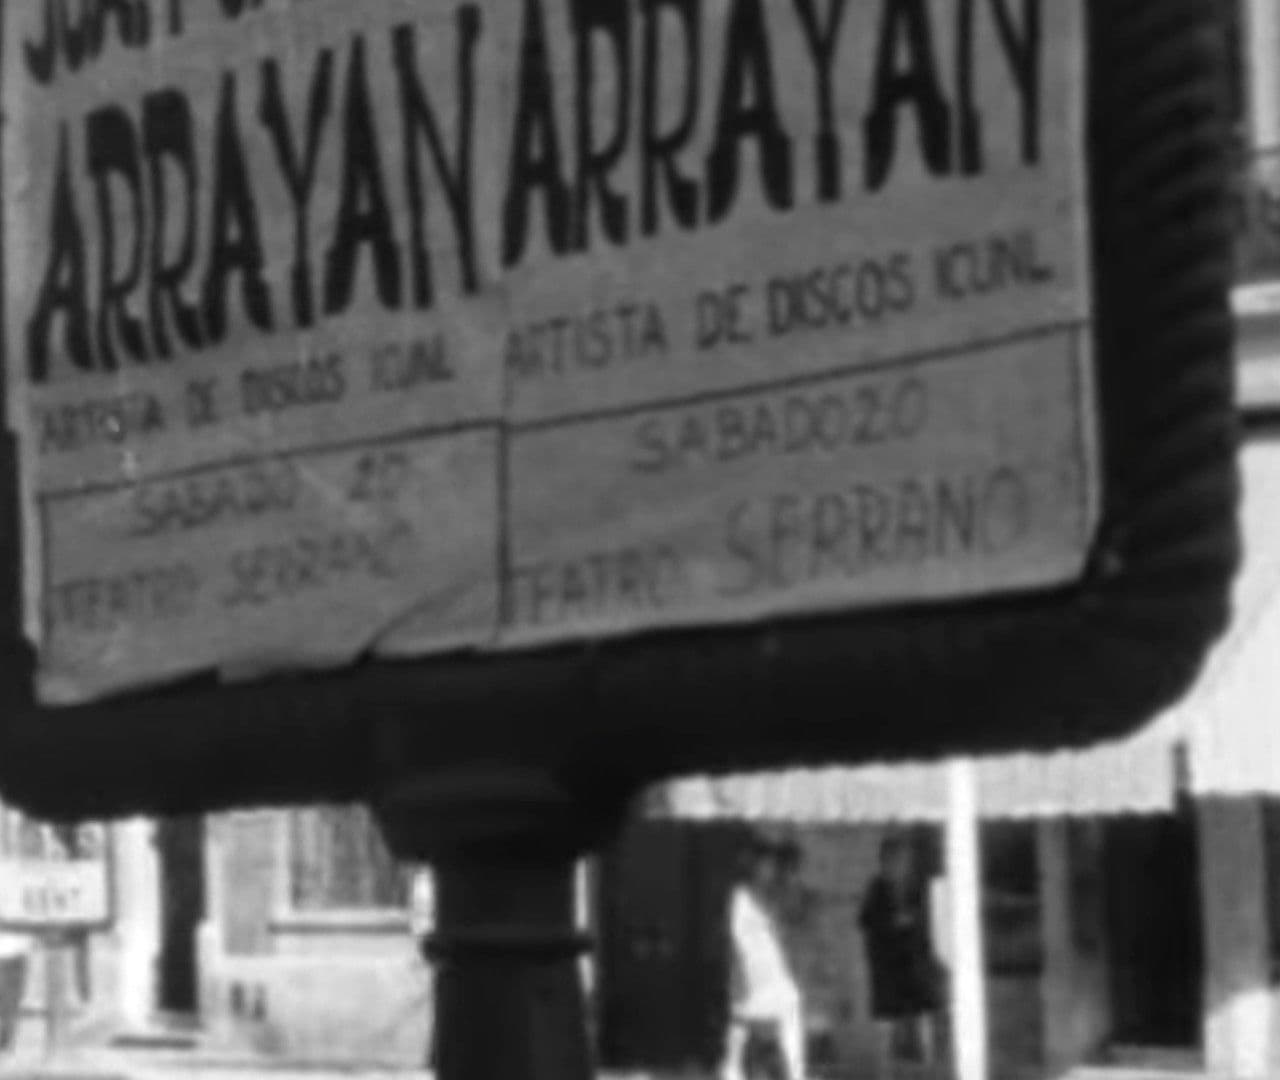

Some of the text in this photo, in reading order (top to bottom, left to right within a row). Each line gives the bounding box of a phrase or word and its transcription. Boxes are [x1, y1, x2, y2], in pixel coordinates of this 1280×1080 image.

[28, 0, 482, 385] ARRAYAN
[502, 302, 668, 378] ARTISTA
[695, 283, 752, 351] DE
[768, 254, 916, 338] DISCOS
